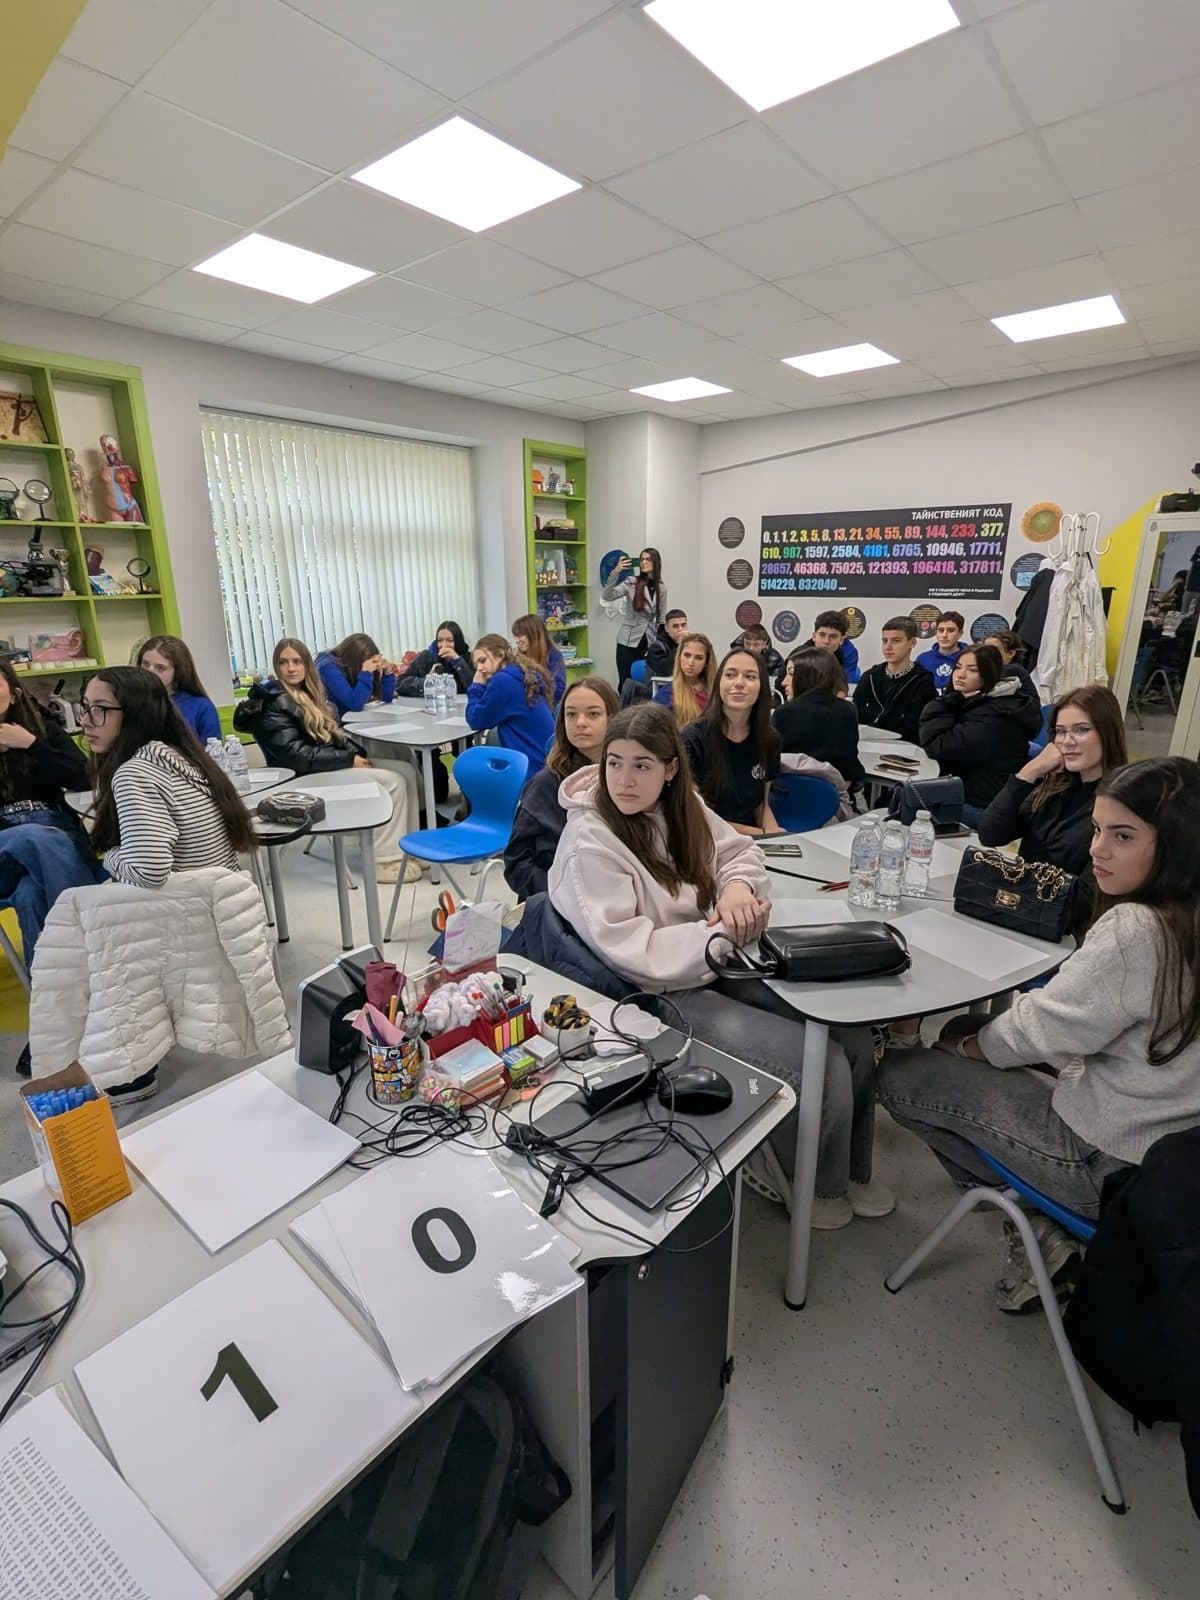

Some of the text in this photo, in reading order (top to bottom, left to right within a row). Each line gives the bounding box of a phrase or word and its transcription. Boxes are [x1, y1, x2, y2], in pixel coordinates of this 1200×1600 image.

[912, 508, 1004, 520] ТАЙНСТВЕНИЯТ КОД
[763, 523, 1005, 544] 0, 1, 1, 2, 3, 5, 8, 13, 21, 34, 55, 89, 144, 233, 377,
[763, 542, 1002, 559] 610, 987, 1597, 2584, 4181, 6765, 10946, 17711,
[762, 563, 793, 575] 28657,
[794, 563, 828, 575] 46368,
[830, 562, 865, 575] 75025,
[868, 561, 909, 575] 121393,
[912, 561, 957, 574] 196418,
[960, 561, 1003, 574] 317811,
[761, 579, 797, 591] 514229,
[412, 1208, 477, 1274] 0
[200, 1342, 278, 1423] 1
